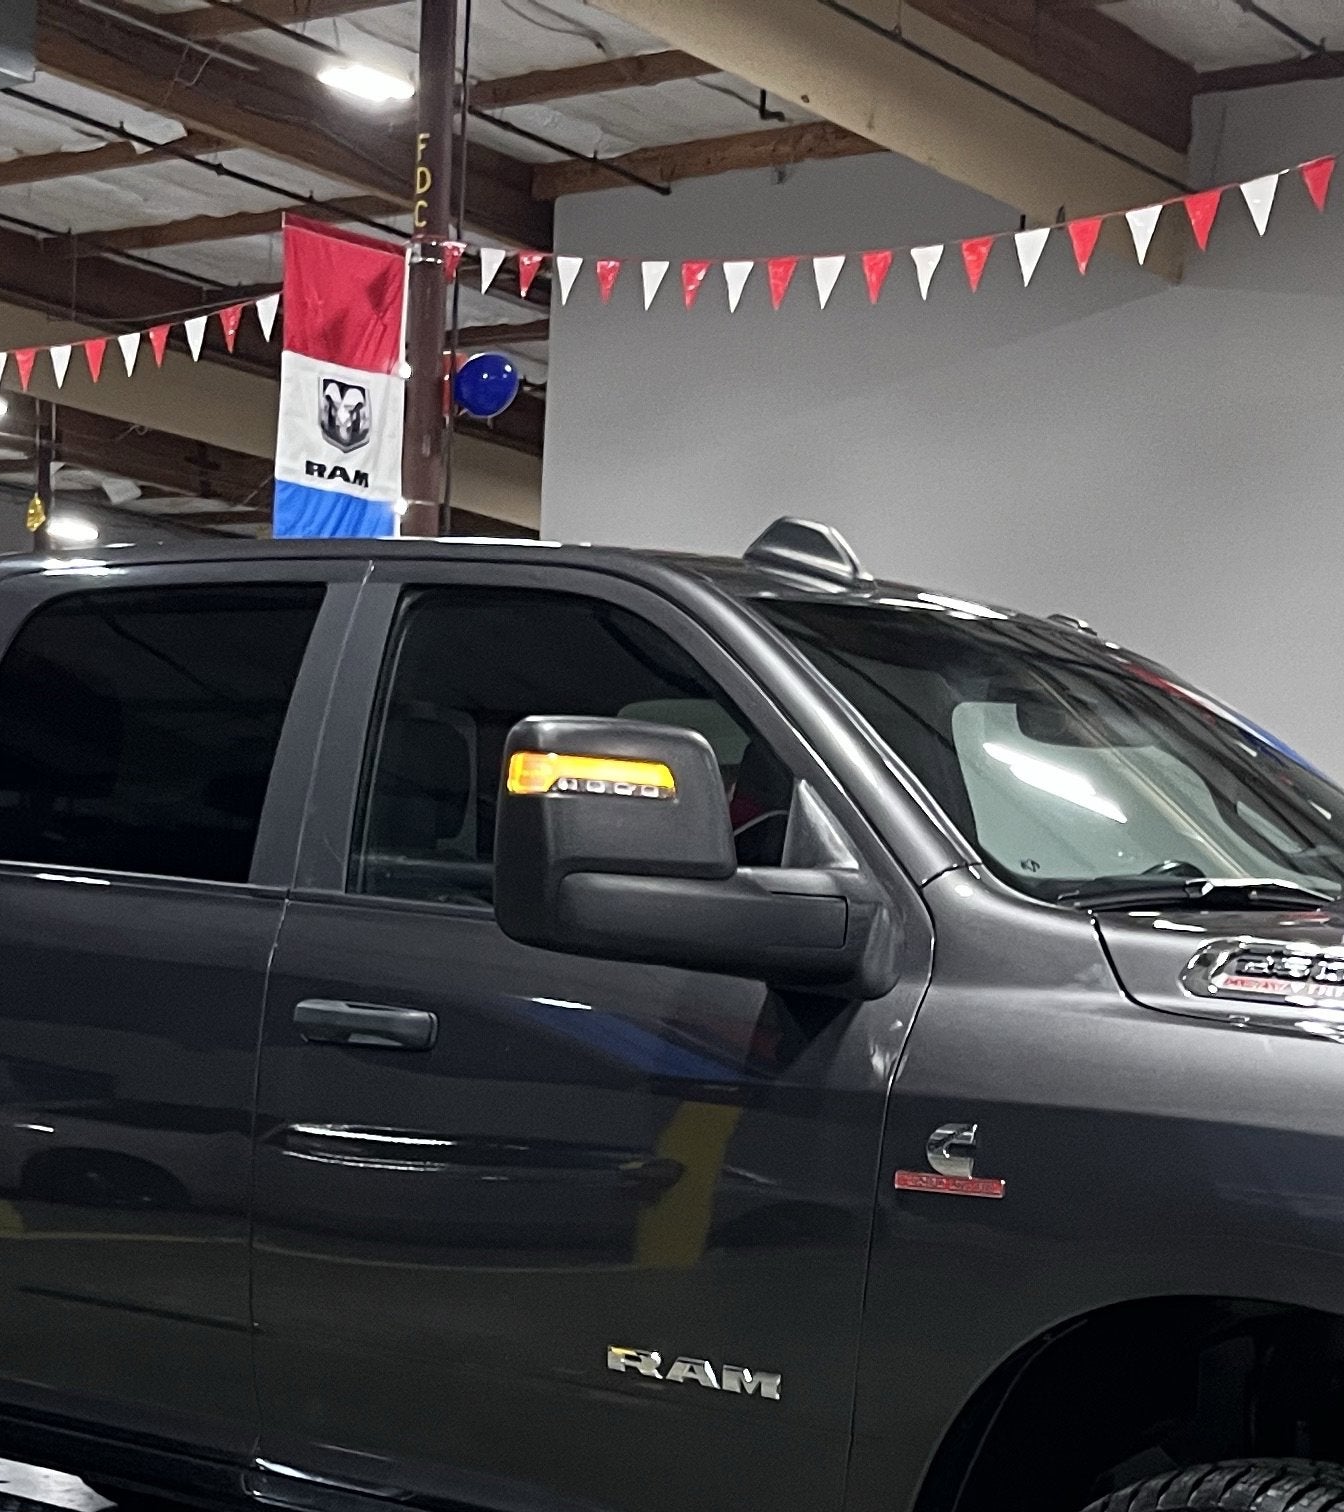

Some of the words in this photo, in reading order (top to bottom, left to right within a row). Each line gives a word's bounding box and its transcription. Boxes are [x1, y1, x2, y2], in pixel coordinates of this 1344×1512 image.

[414, 133, 432, 227] FDC
[305, 460, 369, 488] RAM
[607, 1344, 782, 1400] RAM
